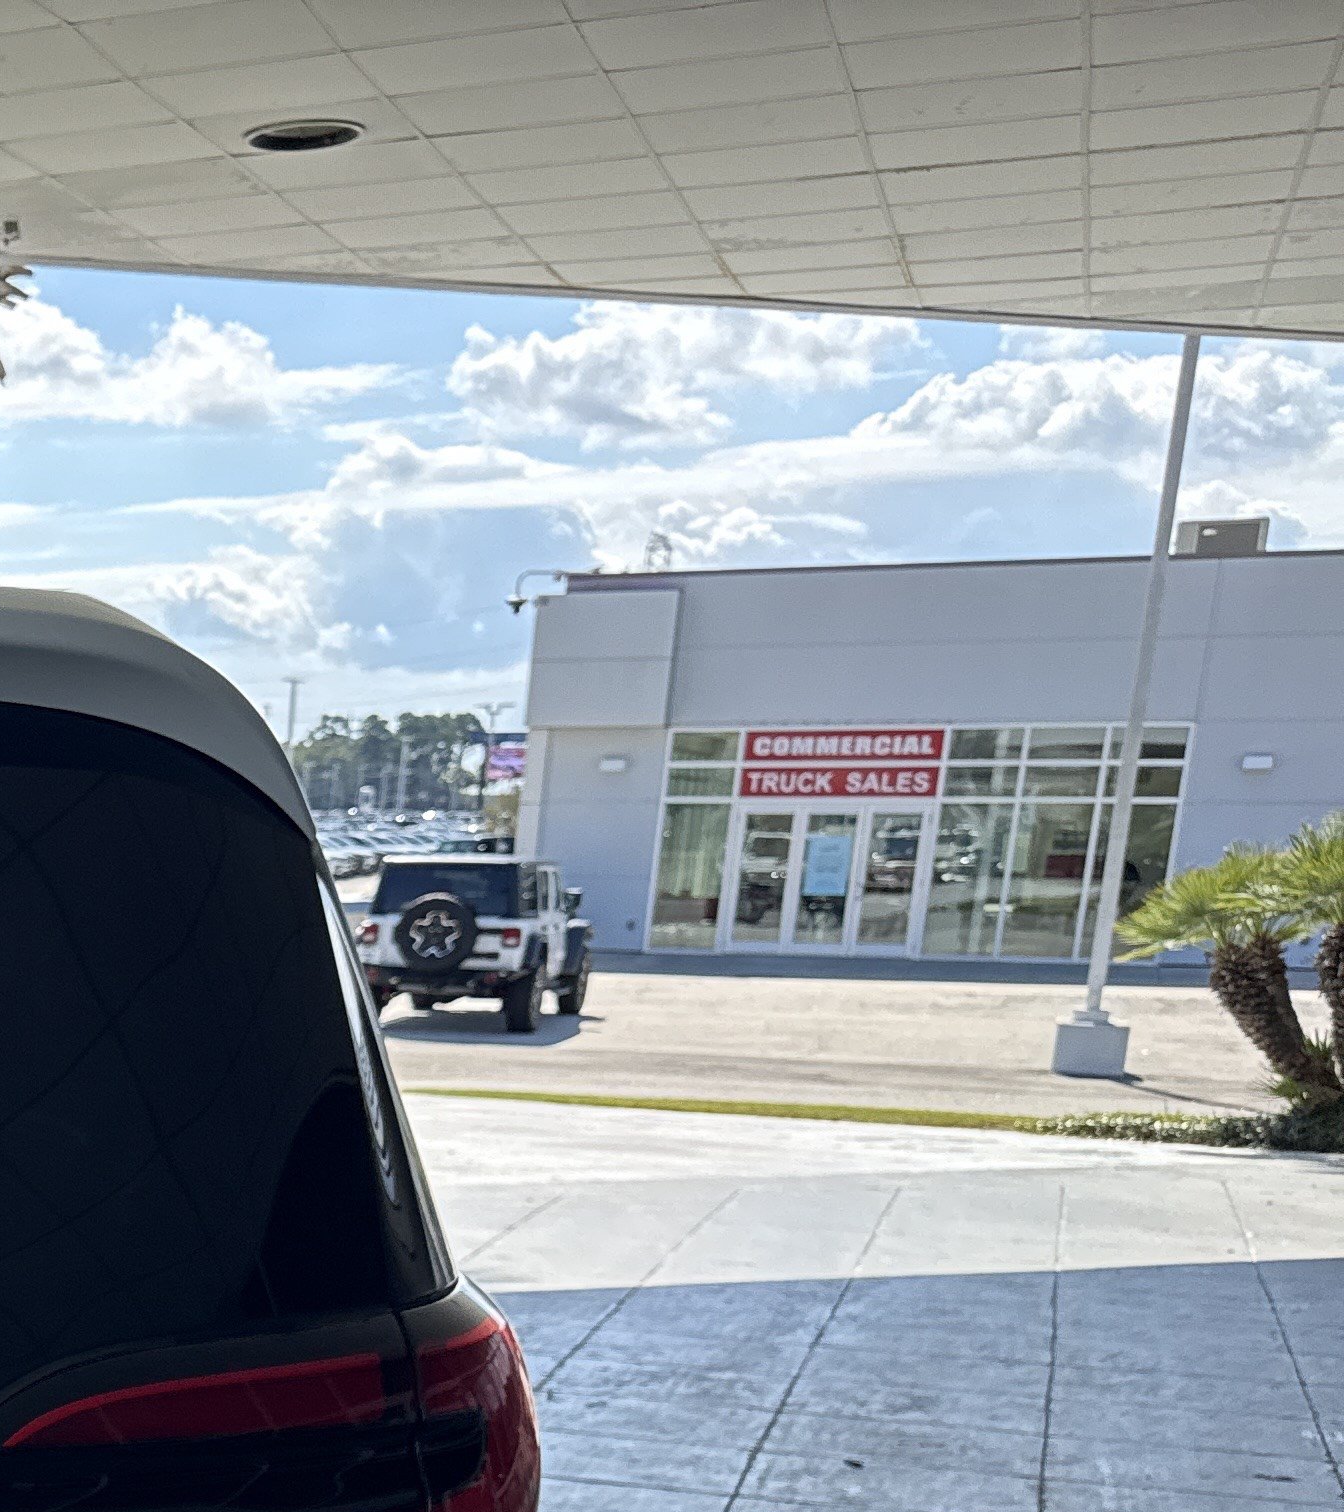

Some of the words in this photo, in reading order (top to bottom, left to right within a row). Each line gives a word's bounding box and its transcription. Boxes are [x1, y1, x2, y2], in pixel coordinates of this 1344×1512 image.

[752, 735, 934, 757] COMMERCIAL
[747, 771, 833, 794] TRUCK
[845, 771, 930, 794] SALES
